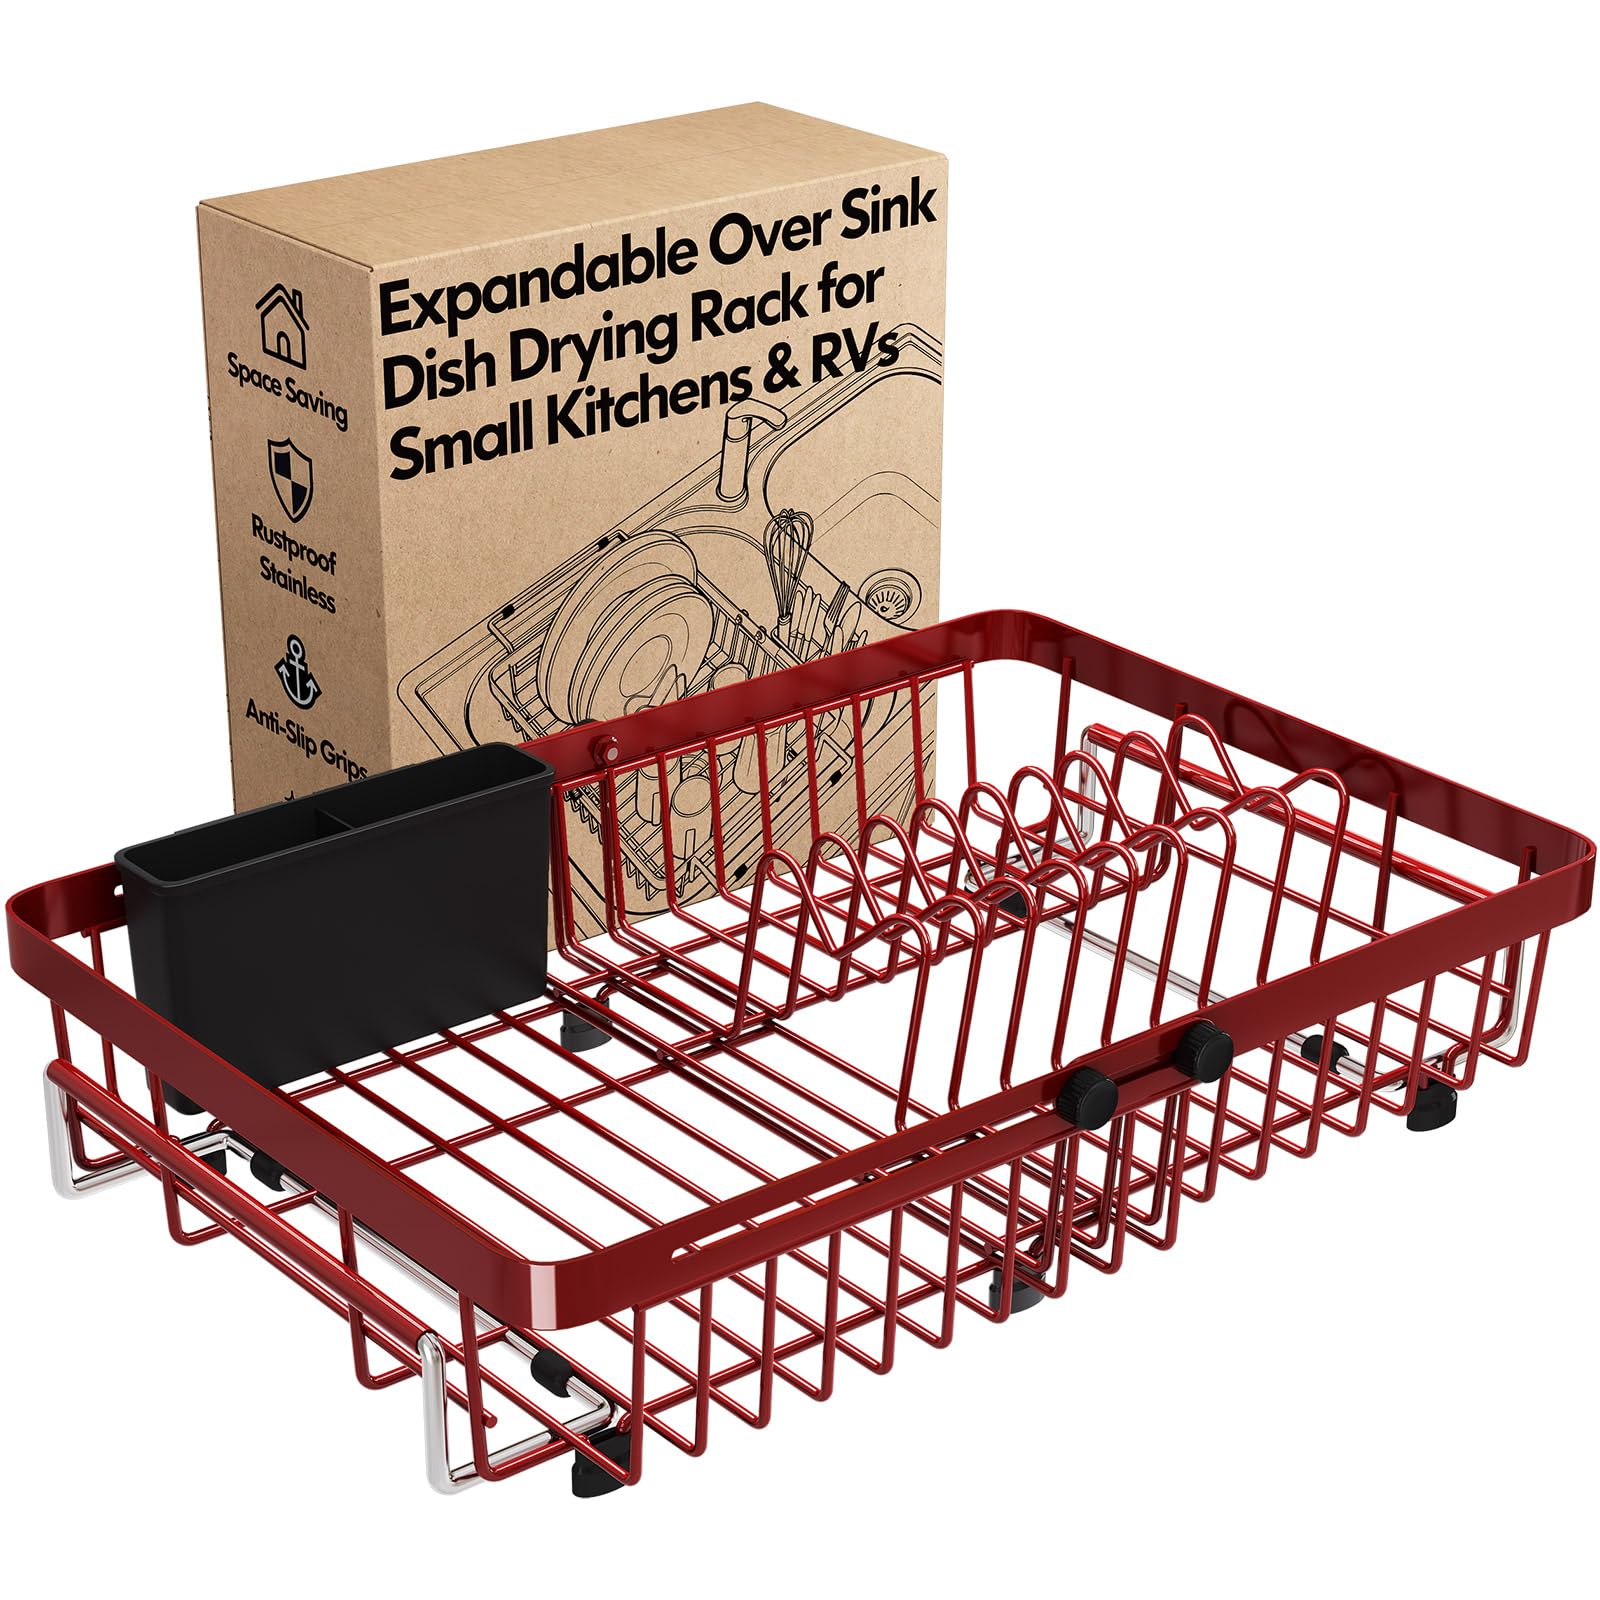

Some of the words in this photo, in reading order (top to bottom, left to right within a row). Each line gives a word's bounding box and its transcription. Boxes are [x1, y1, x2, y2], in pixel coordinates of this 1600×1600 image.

[379, 227, 697, 337] Expandable
[709, 208, 832, 266] Over
[840, 176, 938, 240] Sink
[382, 338, 497, 410] Dish
[509, 311, 678, 383] Drying
[690, 272, 809, 342] Rack
[815, 260, 885, 312] for
[227, 352, 282, 397] Space
[285, 376, 348, 432] Saving
[389, 399, 533, 480] Small
[546, 363, 753, 445] Kitchens
[763, 342, 801, 393] &
[811, 321, 899, 383] RVs
[251, 512, 337, 576] Rustproof
[260, 555, 336, 614] Stainless
[245, 698, 318, 758] Anti-Slip
[320, 740, 368, 782] Grips
